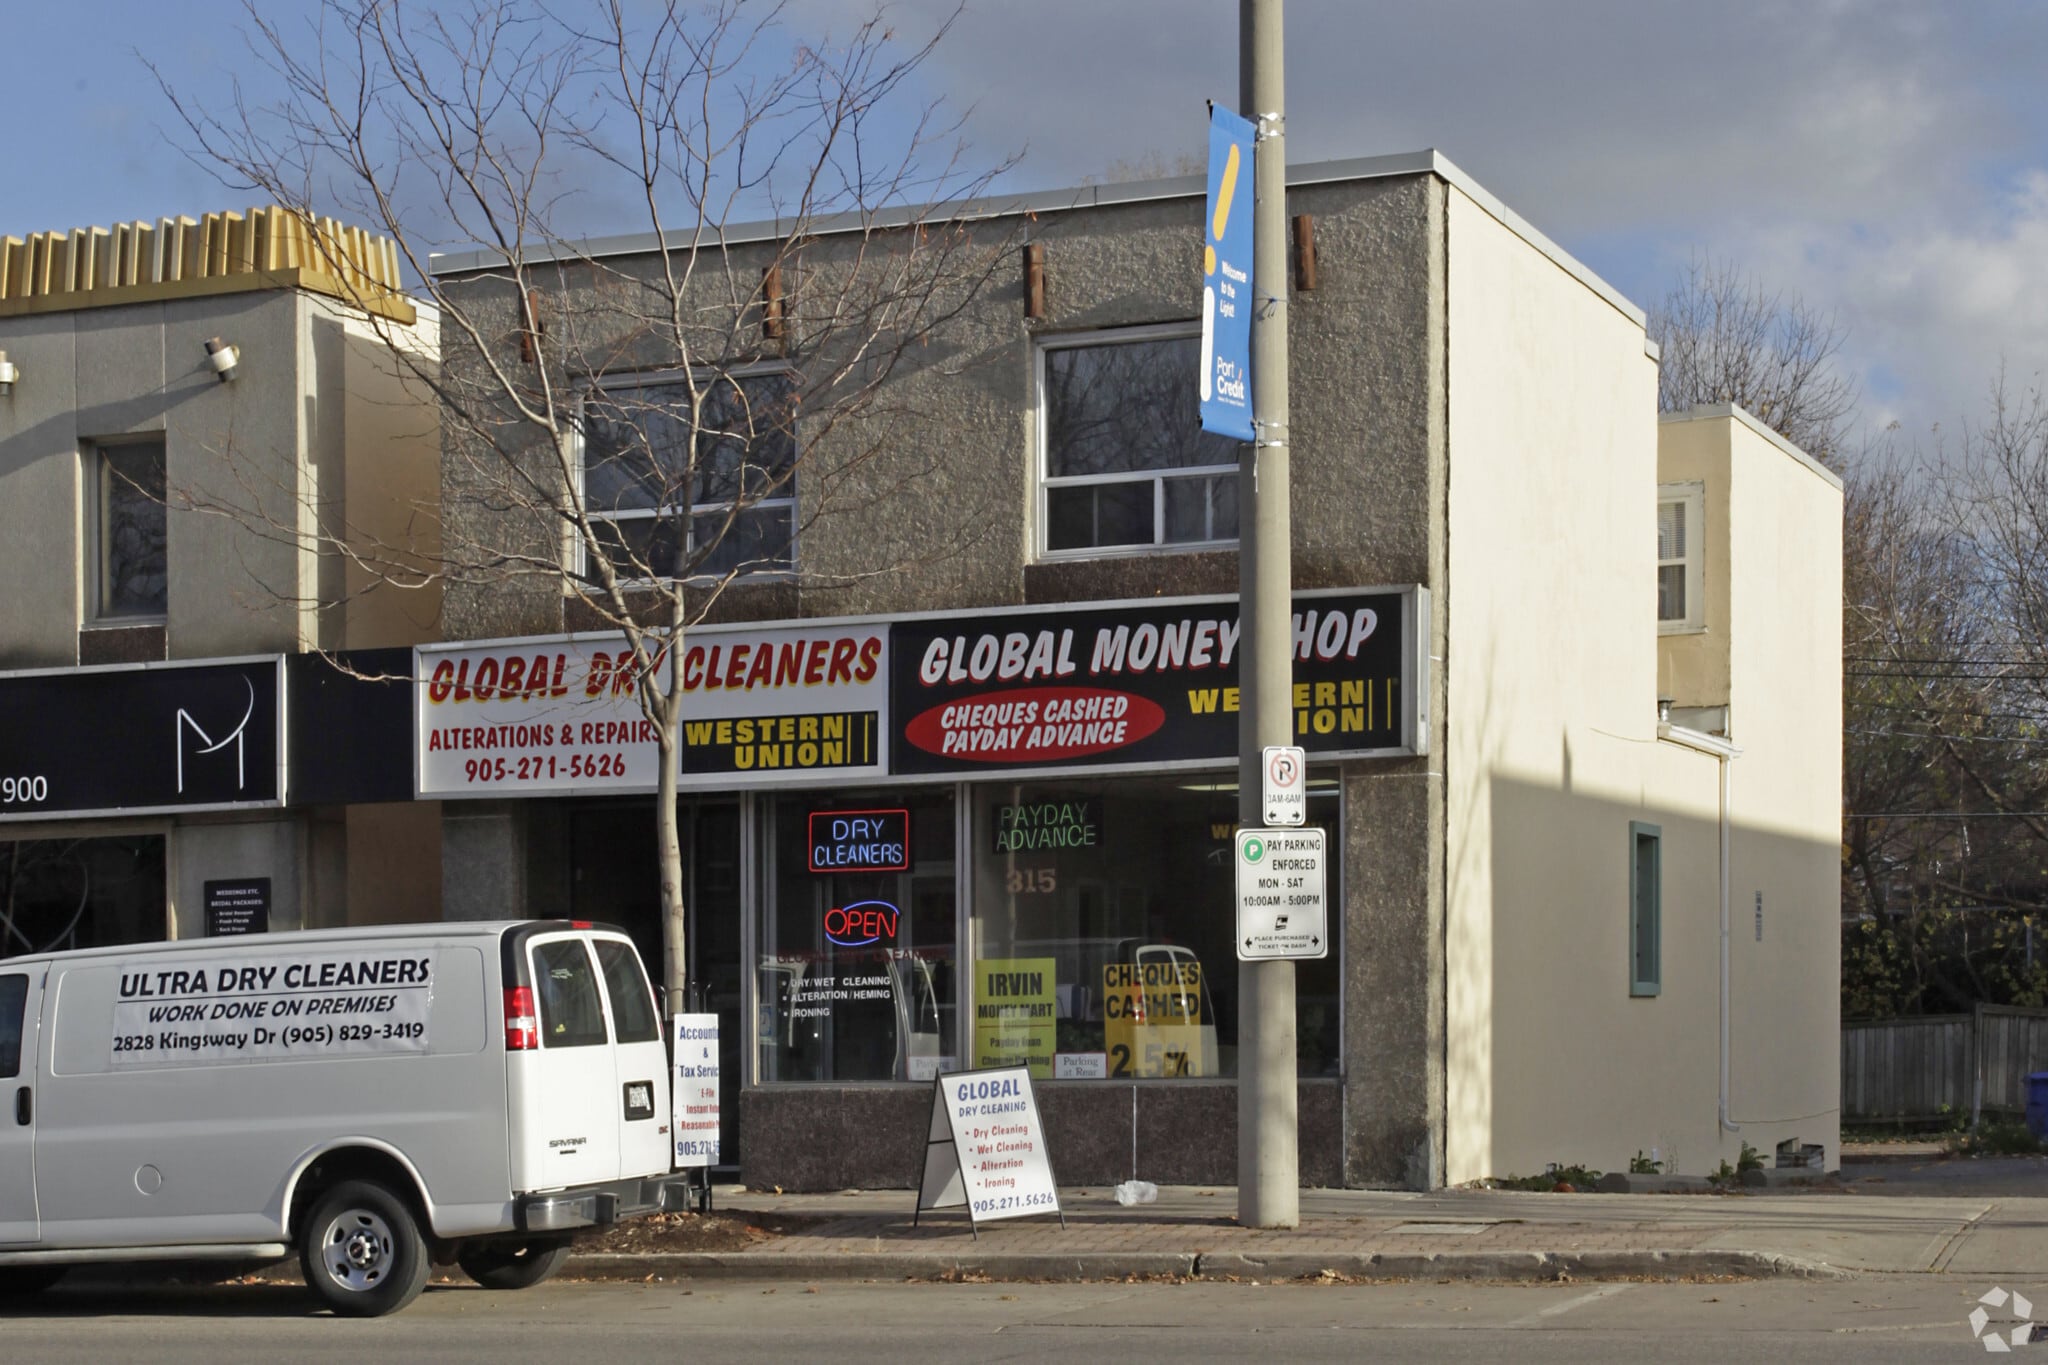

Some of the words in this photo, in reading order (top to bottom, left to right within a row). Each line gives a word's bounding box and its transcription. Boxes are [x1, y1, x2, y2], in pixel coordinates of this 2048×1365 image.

[1221, 260, 1247, 283] Welcome
[1217, 356, 1234, 378] Port
[1217, 371, 1244, 399] Credit
[919, 628, 1076, 688] GLOBAL
[1090, 616, 1240, 676] MONEY
[1292, 608, 1378, 662] HOP
[428, 653, 568, 705] GLOBAL
[683, 636, 882, 692] CLEANERS
[1188, 679, 1364, 714] WEERN
[941, 702, 1039, 730] CHEQUES
[1043, 696, 1128, 723] CASHED
[429, 724, 554, 752] ALTERATIONS
[562, 724, 574, 746] &
[686, 715, 843, 746] WESTERN
[942, 726, 1023, 754] PAYDAY
[1025, 720, 1128, 750] ADVANCE
[735, 741, 843, 769] UNION
[465, 753, 626, 783] 905-271-5626
[1001, 803, 1088, 827] PAYDAY
[832, 818, 885, 841] DRY
[997, 825, 1096, 851] ADVANCE
[814, 844, 903, 866] CLEANERS
[1267, 840, 1282, 851] PAY
[1285, 839, 1321, 850] PARKING
[1272, 859, 1316, 871] ENFORCED
[1259, 879, 1279, 888] MON
[1287, 878, 1304, 888] SAT
[1244, 896, 1280, 906] 10:00AM
[1288, 895, 1320, 905] 5:00PM
[825, 908, 898, 937] OPEN
[120, 969, 208, 998] ULTRA
[216, 965, 277, 994] DRY
[284, 957, 430, 989] CLEANERS
[843, 976, 891, 987] CLEANING
[988, 972, 1042, 996] IRVIN
[1105, 963, 1199, 987] CHEQUES
[149, 1004, 208, 1024] WORK
[210, 1001, 268, 1021] DONE
[272, 999, 301, 1018] ON
[305, 995, 397, 1017] PREMISES
[791, 1008, 830, 1018] IRONING
[978, 1004, 1017, 1018] MONEY
[1020, 1003, 1053, 1017] MART
[1106, 993, 1199, 1019] CASHED
[113, 1034, 155, 1053] 2828
[159, 1028, 248, 1054] Kingsway
[253, 1027, 276, 1046] Dr
[281, 1023, 334, 1048] (905)
[339, 1021, 424, 1042] 829-3419
[680, 1065, 695, 1078] Tax
[1063, 1057, 1098, 1067] Parking
[1064, 1068, 1071, 1076] at
[1076, 1067, 1096, 1077] Rear
[958, 1079, 1020, 1101] GLOBAL
[959, 1106, 977, 1117] DRY
[981, 1101, 1026, 1115] CLEANING
[549, 1137, 587, 1149] SAVANA
[973, 1128, 988, 1140] Dry
[992, 1124, 1028, 1136] Cleaning
[977, 1145, 993, 1154] Wet
[996, 1141, 1032, 1153] Cleaning
[980, 1159, 1023, 1172] Alteration
[985, 1178, 1015, 1188] Ironing
[973, 1192, 1053, 1213] 905.271.5626
